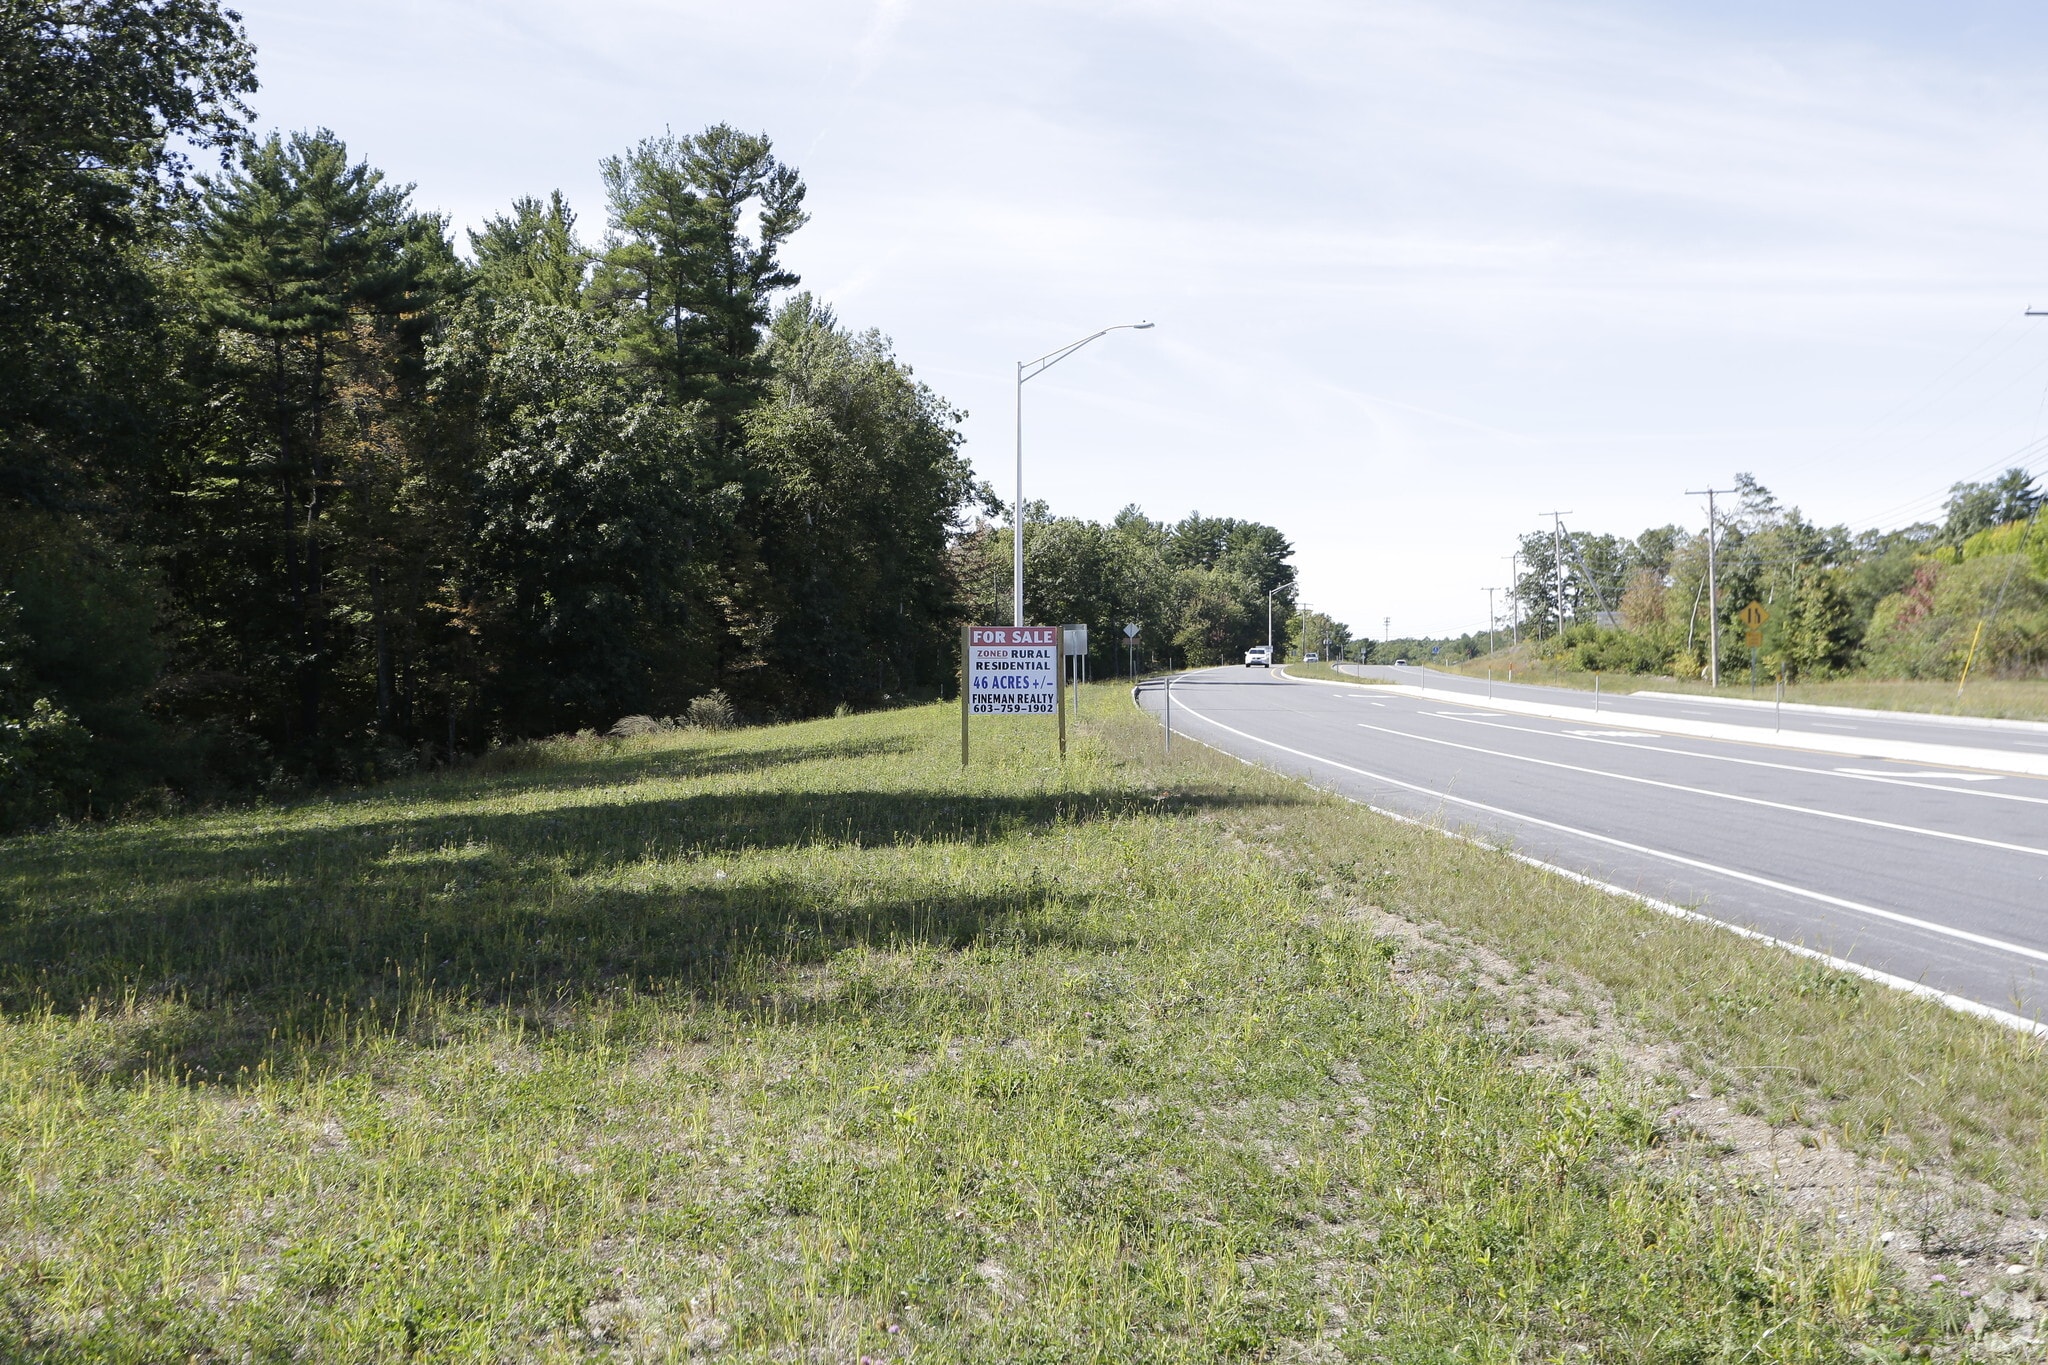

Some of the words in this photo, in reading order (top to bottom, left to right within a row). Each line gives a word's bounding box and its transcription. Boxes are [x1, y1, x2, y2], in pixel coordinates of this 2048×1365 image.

[973, 631, 1006, 643] FOR
[1012, 631, 1053, 643] SALE
[977, 650, 1008, 658] ZONED
[1011, 650, 1050, 658] RURAL
[976, 662, 1050, 670] RESIDENTIAL
[974, 676, 988, 689] 46
[992, 676, 1029, 689] ACRES
[1033, 676, 1053, 689] +/-
[973, 694, 1014, 704] FINEMAN
[1018, 694, 1054, 704] REALTY
[974, 704, 1053, 713] 603-759-1902
